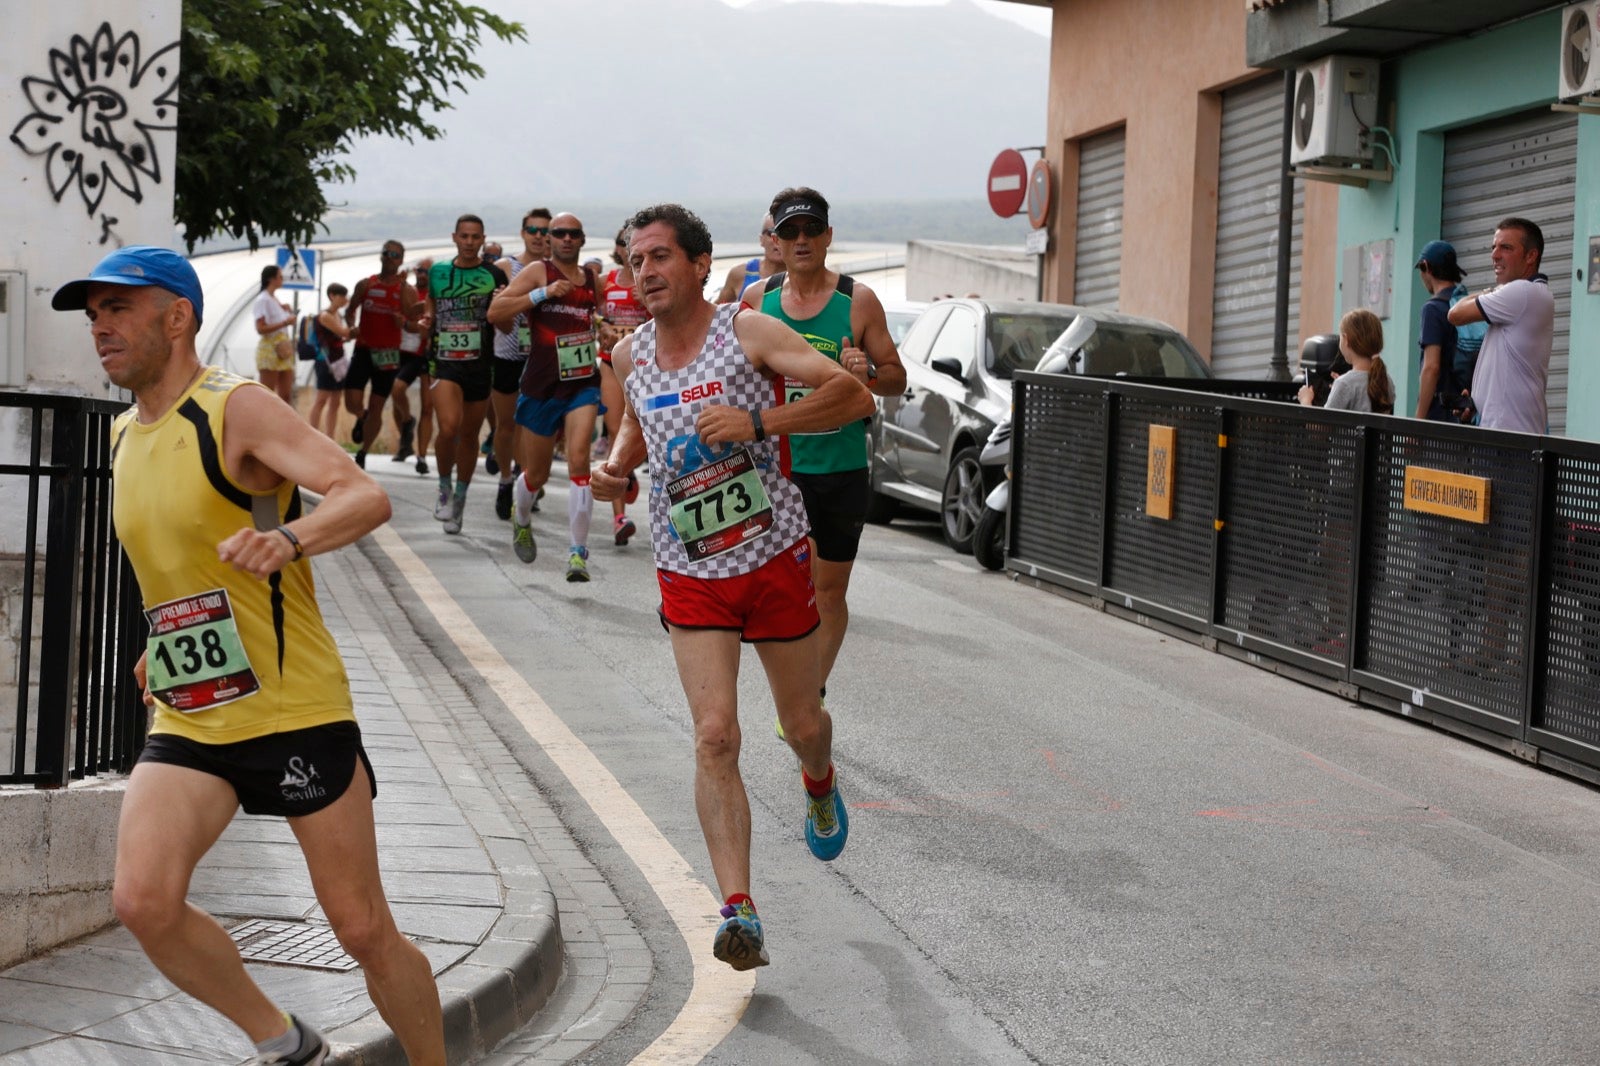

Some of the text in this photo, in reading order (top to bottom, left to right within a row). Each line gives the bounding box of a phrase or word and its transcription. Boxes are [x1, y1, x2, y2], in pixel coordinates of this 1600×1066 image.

[785, 204, 811, 213] 2XU
[450, 334, 469, 347] 33
[574, 345, 592, 363] 11
[681, 381, 723, 403] SEUR
[680, 475, 696, 492] GRAN
[695, 466, 718, 485] PREMIO
[717, 463, 726, 474] DE
[725, 455, 745, 471] FONDO
[684, 482, 752, 531] 773
[1410, 478, 1478, 511] CERVEZAS ALHAMBRA
[161, 602, 191, 621] PREMIO
[190, 599, 201, 612] DE
[200, 594, 222, 611] FONDO
[155, 628, 228, 678] 138
[282, 784, 326, 801] Sevilla
